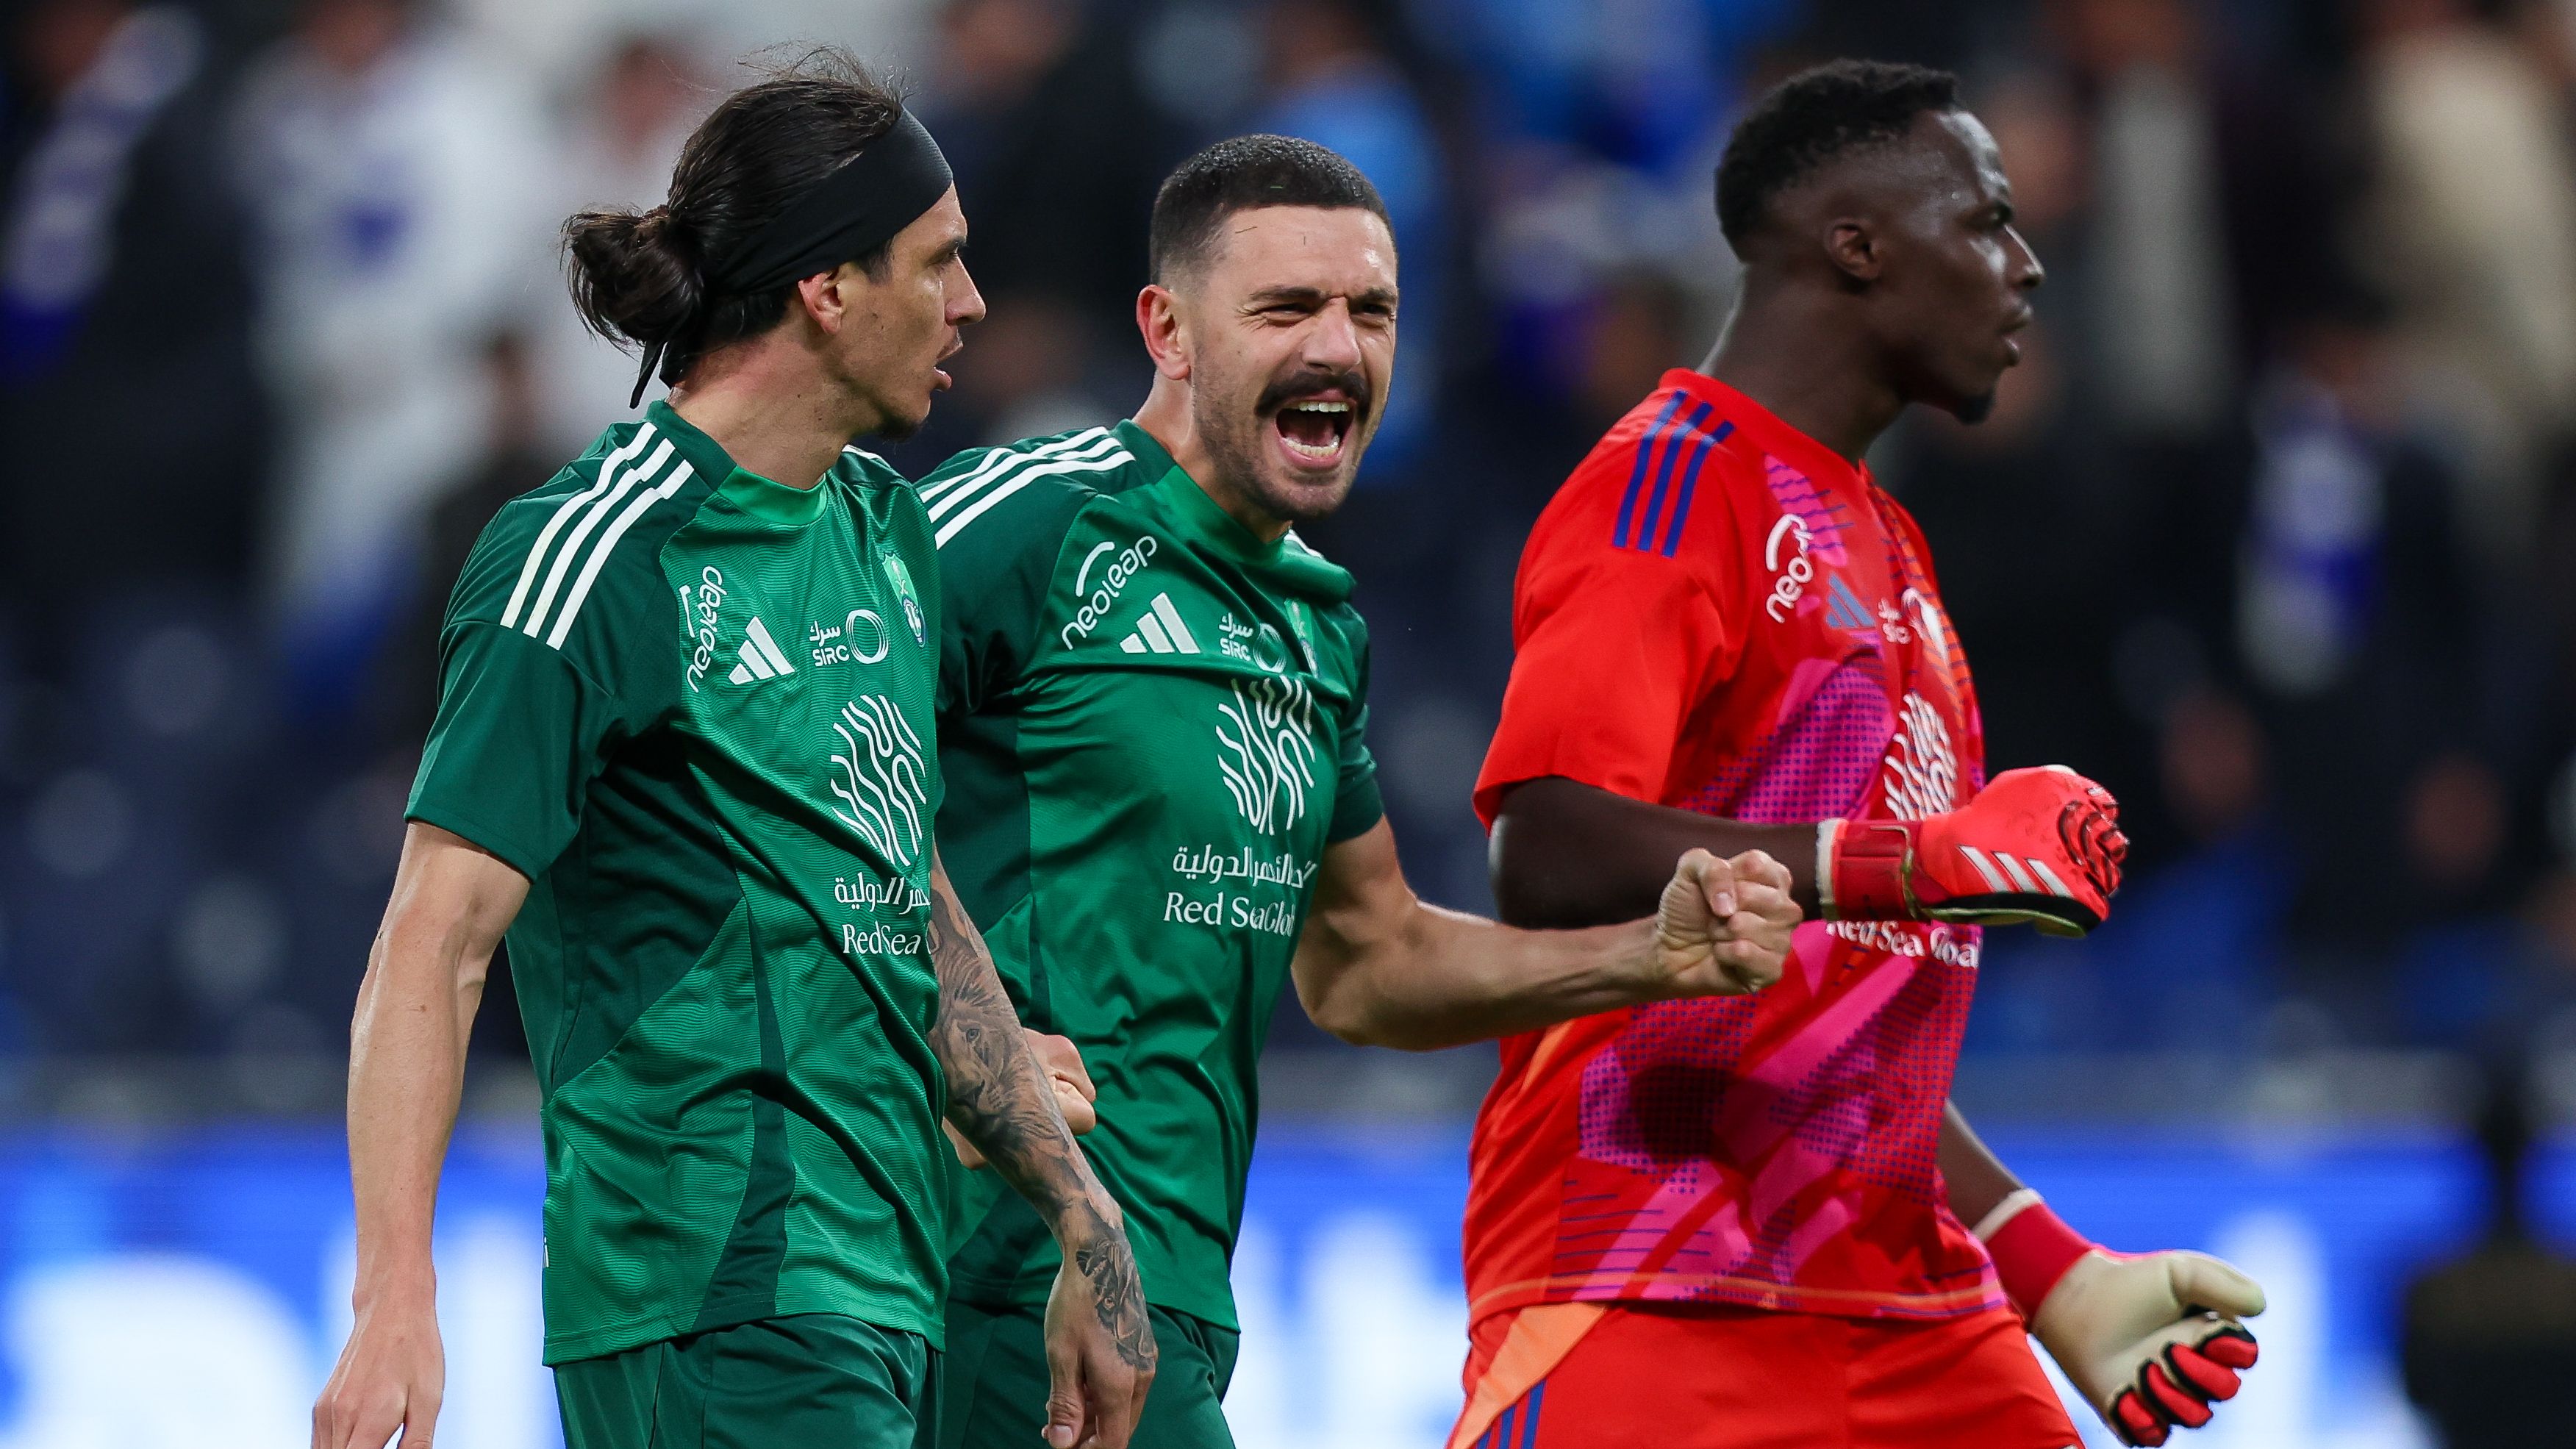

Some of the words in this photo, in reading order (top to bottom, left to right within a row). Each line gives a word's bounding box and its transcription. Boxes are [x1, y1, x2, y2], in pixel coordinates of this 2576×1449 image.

[1061, 535, 1158, 651] neoleap
[687, 565, 728, 693] neoleap
[809, 620, 842, 648] سرك
[1218, 612, 1254, 640] سرك
[812, 644, 850, 667] SIRC
[1219, 637, 1252, 662] SIRC
[1173, 843, 1254, 884] الدولية
[1162, 890, 1225, 926] Red
[841, 920, 882, 955] Red
[881, 924, 922, 956] Sea
[1876, 920, 1926, 958] Sea
